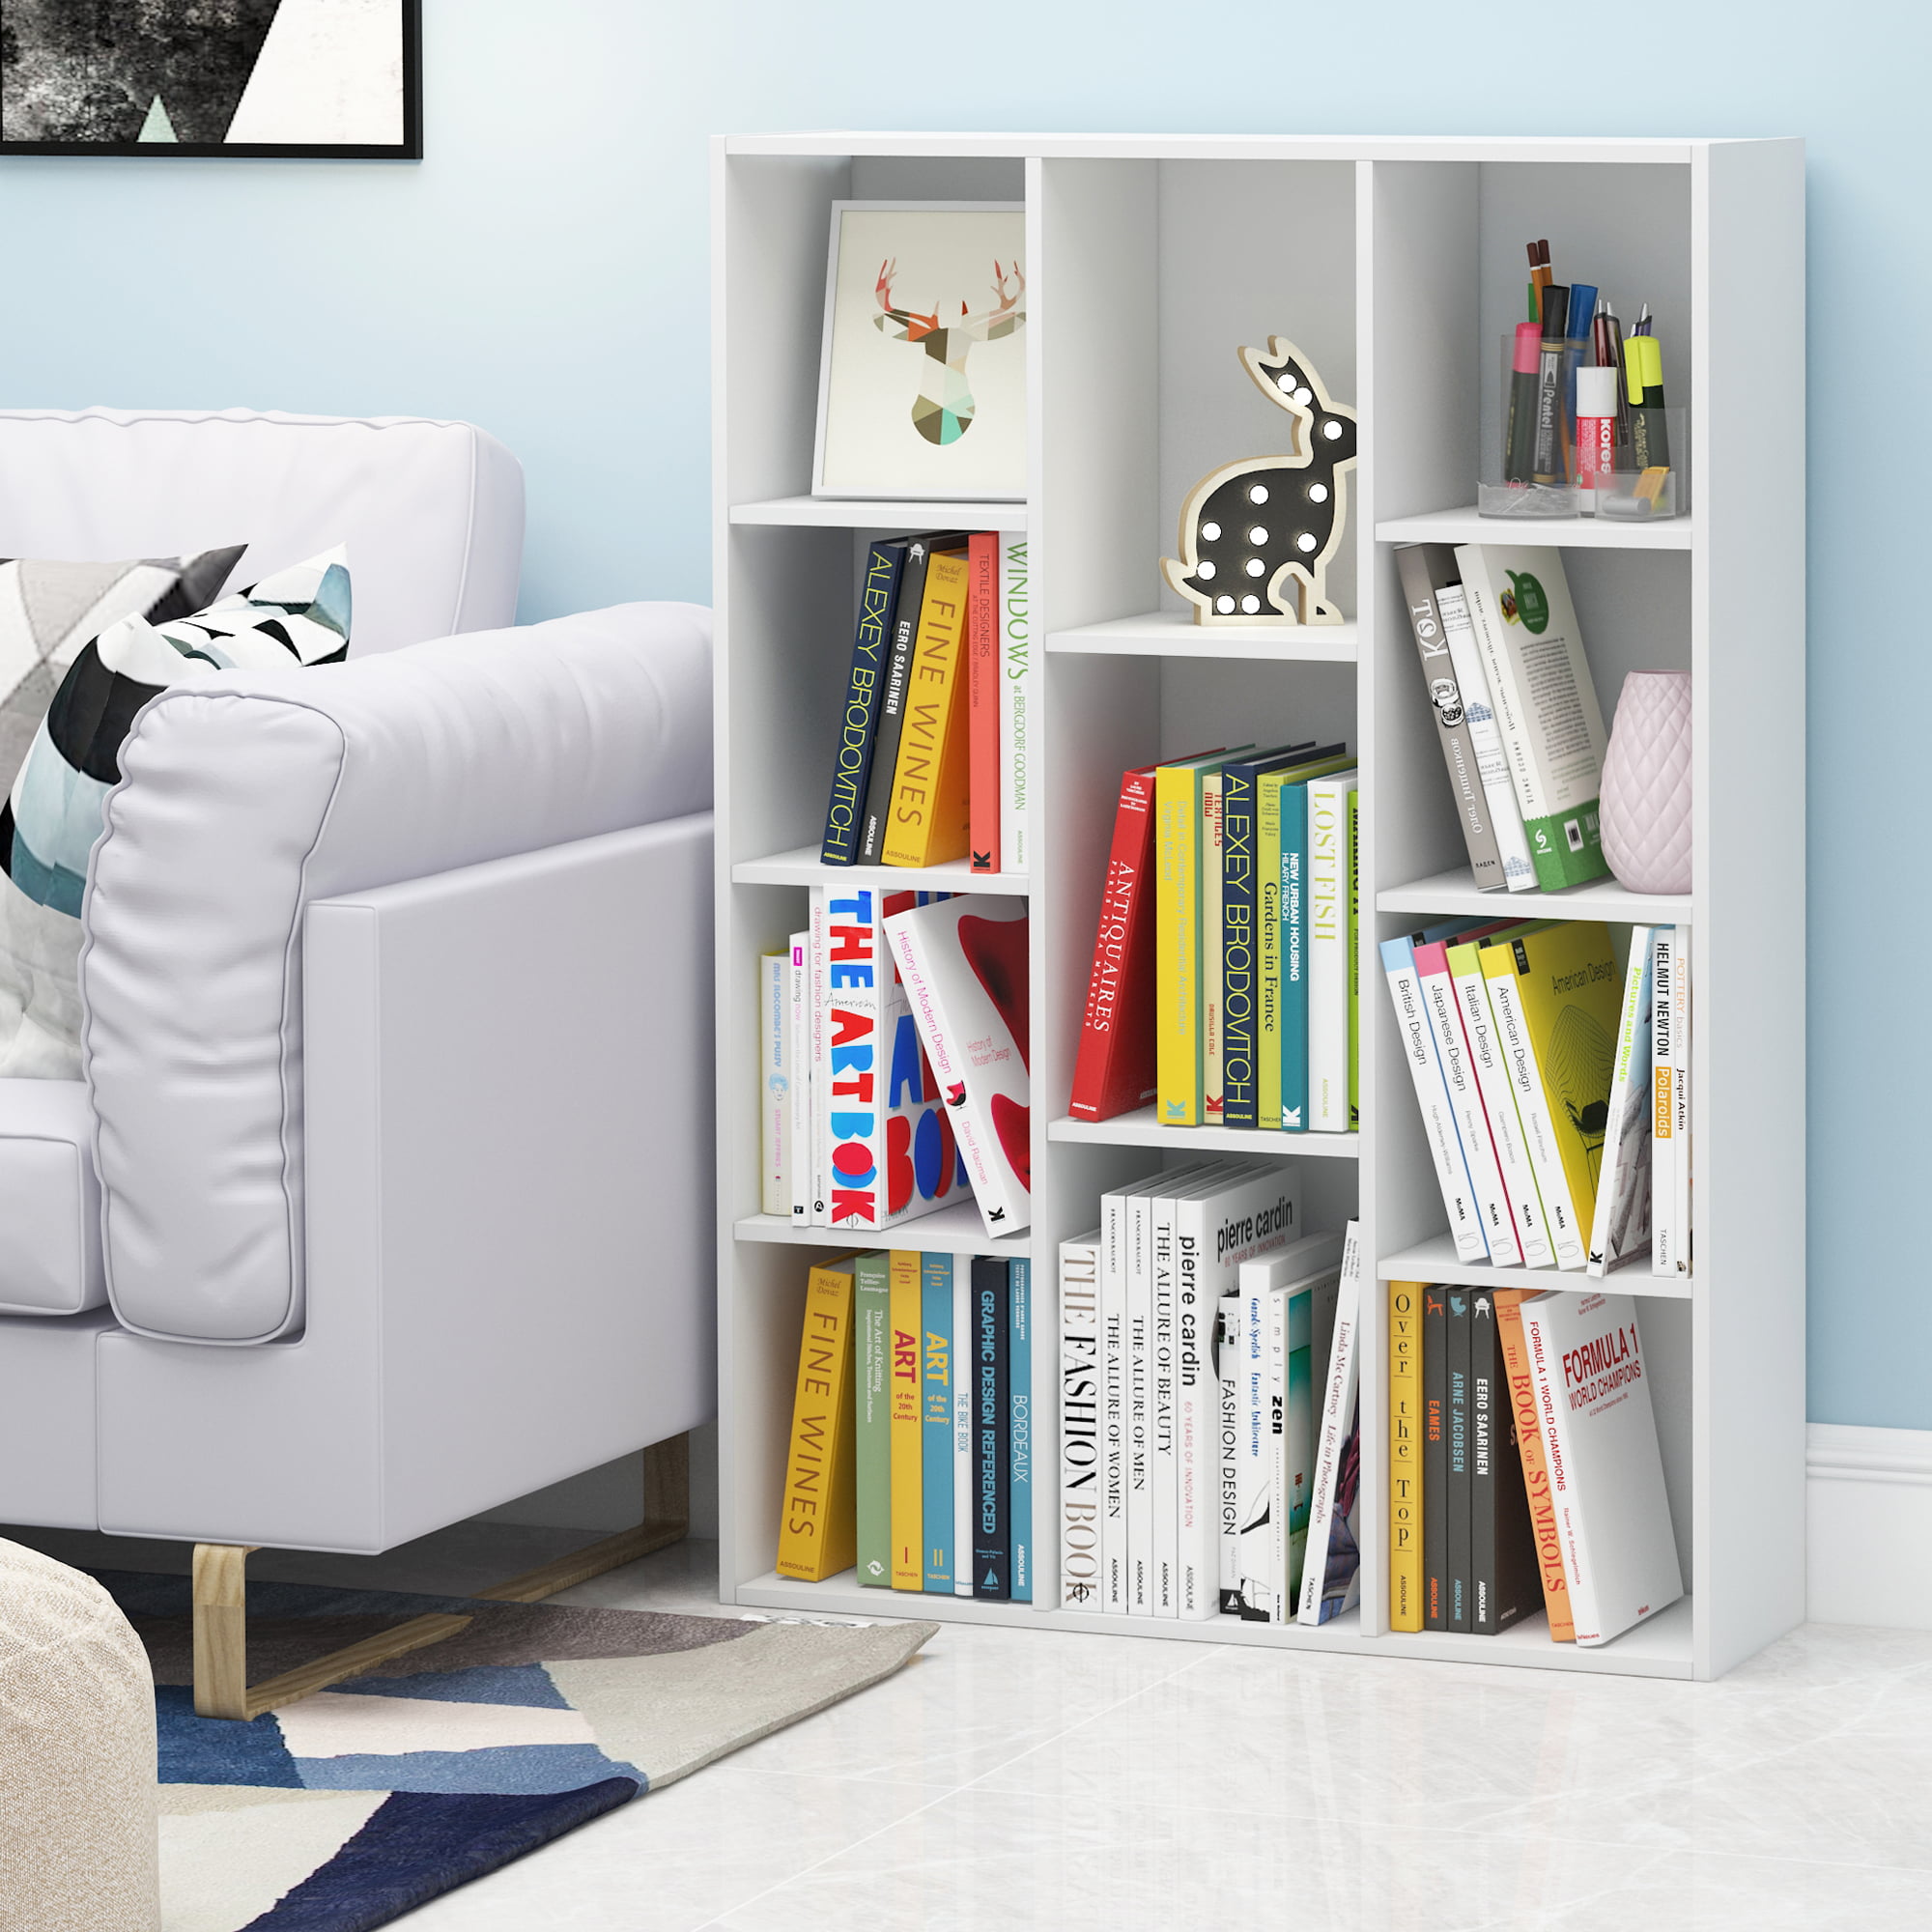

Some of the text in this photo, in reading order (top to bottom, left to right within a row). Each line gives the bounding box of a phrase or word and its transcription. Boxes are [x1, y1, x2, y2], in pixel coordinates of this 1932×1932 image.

[1541, 387, 1555, 429] Pentel
[980, 554, 990, 658] TEXTILE DESIGNERS
[827, 552, 893, 847] ALEXEY BRODOVITCH
[886, 620, 911, 715] EERO SAARINEN
[1007, 542, 1028, 810] WINDOWS BERGDORF GOODMAN
[896, 599, 955, 827] FINE WINES
[865, 815, 877, 857] ASSOULINE
[886, 849, 922, 864] ASSOULINE
[1281, 853, 1290, 884] HILARY
[1314, 792, 1336, 940] LOST FISH
[812, 906, 823, 950] drawing
[830, 891, 874, 989] THE
[1094, 861, 1135, 1033] ANTIQUAIRES
[1225, 773, 1252, 1104] ALEXEY BRODOVITCH
[1264, 882, 1278, 1032] Gardens in France
[1290, 853, 1299, 981] NEW URBAN HOUSING
[793, 970, 803, 1003] drawing
[814, 952, 823, 966] for
[814, 969, 823, 1008] fashion
[1551, 959, 1616, 997] American Design
[1657, 943, 1670, 1056] HELMUT NEWTON
[812, 1010, 823, 1063] designers
[897, 930, 952, 1074] History of Modern Design
[1397, 979, 1428, 1065] British Design
[1432, 984, 1466, 1092] Japanese Design
[1464, 984, 1493, 1068] Italian Design
[1497, 986, 1532, 1093] American Design
[1619, 967, 1642, 1083] Pictures and Words
[1676, 957, 1686, 1049] POTTERY basics
[831, 1009, 874, 1103] ART
[1676, 1068, 1686, 1099] Jacqui
[961, 1121, 975, 1147] David
[1657, 1068, 1670, 1137] Polaroids
[1217, 1196, 1293, 1263] pierre cardin
[872, 1310, 883, 1392] The Art of Knitting
[980, 1291, 995, 1362] GRAPHIC
[1157, 1222, 1171, 1457] THE ALLURE OF BEAUTY
[1179, 1236, 1201, 1386] pierre cardin
[895, 1329, 917, 1384] ART
[925, 1331, 949, 1386] ART
[981, 1366, 996, 1425] DESIGN
[1506, 1345, 1520, 1369] THE
[1562, 1322, 1639, 1388] FORMULA 1
[1569, 1381, 1597, 1411] WORLD
[1597, 1359, 1642, 1397] CHAMPIONS
[788, 1312, 838, 1538] FINE WINES
[893, 1412, 918, 1423] Century
[904, 1392, 915, 1401] the
[957, 1392, 969, 1453] THE BOOK
[1064, 1250, 1098, 1603] THE FASHION BOOK
[1107, 1313, 1121, 1519] THE ALLURE OF WOMEN
[1132, 1315, 1145, 1491] THE ALLURE OF MEN
[1222, 1378, 1236, 1461] FASHION
[1271, 1396, 1283, 1435] zen
[1315, 1321, 1350, 1523] Linda Photographs
[1398, 1400, 1408, 1457] the
[1429, 1400, 1440, 1441] EAMES
[1452, 1372, 1464, 1472] ARNE JACOBSEN
[1476, 1378, 1489, 1475] EERO SAARINEN
[1512, 1375, 1541, 1445] BOOK
[1529, 1321, 1567, 1492] FORMULA WORLD CHAMPIONS
[1012, 1395, 1029, 1483] BORDEAUX
[1184, 1416, 1194, 1528] YEARS INNOVATION
[1524, 1449, 1536, 1465] OF
[981, 1430, 996, 1534] REFERENCED
[1222, 1467, 1236, 1536] DESIGN
[1563, 1507, 1572, 1529] Rainer
[780, 1560, 815, 1574] ASSOULINE
[1528, 1470, 1566, 1592] SYMBOLS
[1306, 1577, 1316, 1611] TASCHEN
[1430, 1577, 1438, 1619] ASSOULINE
[1478, 1580, 1487, 1623] ASSOULINE
